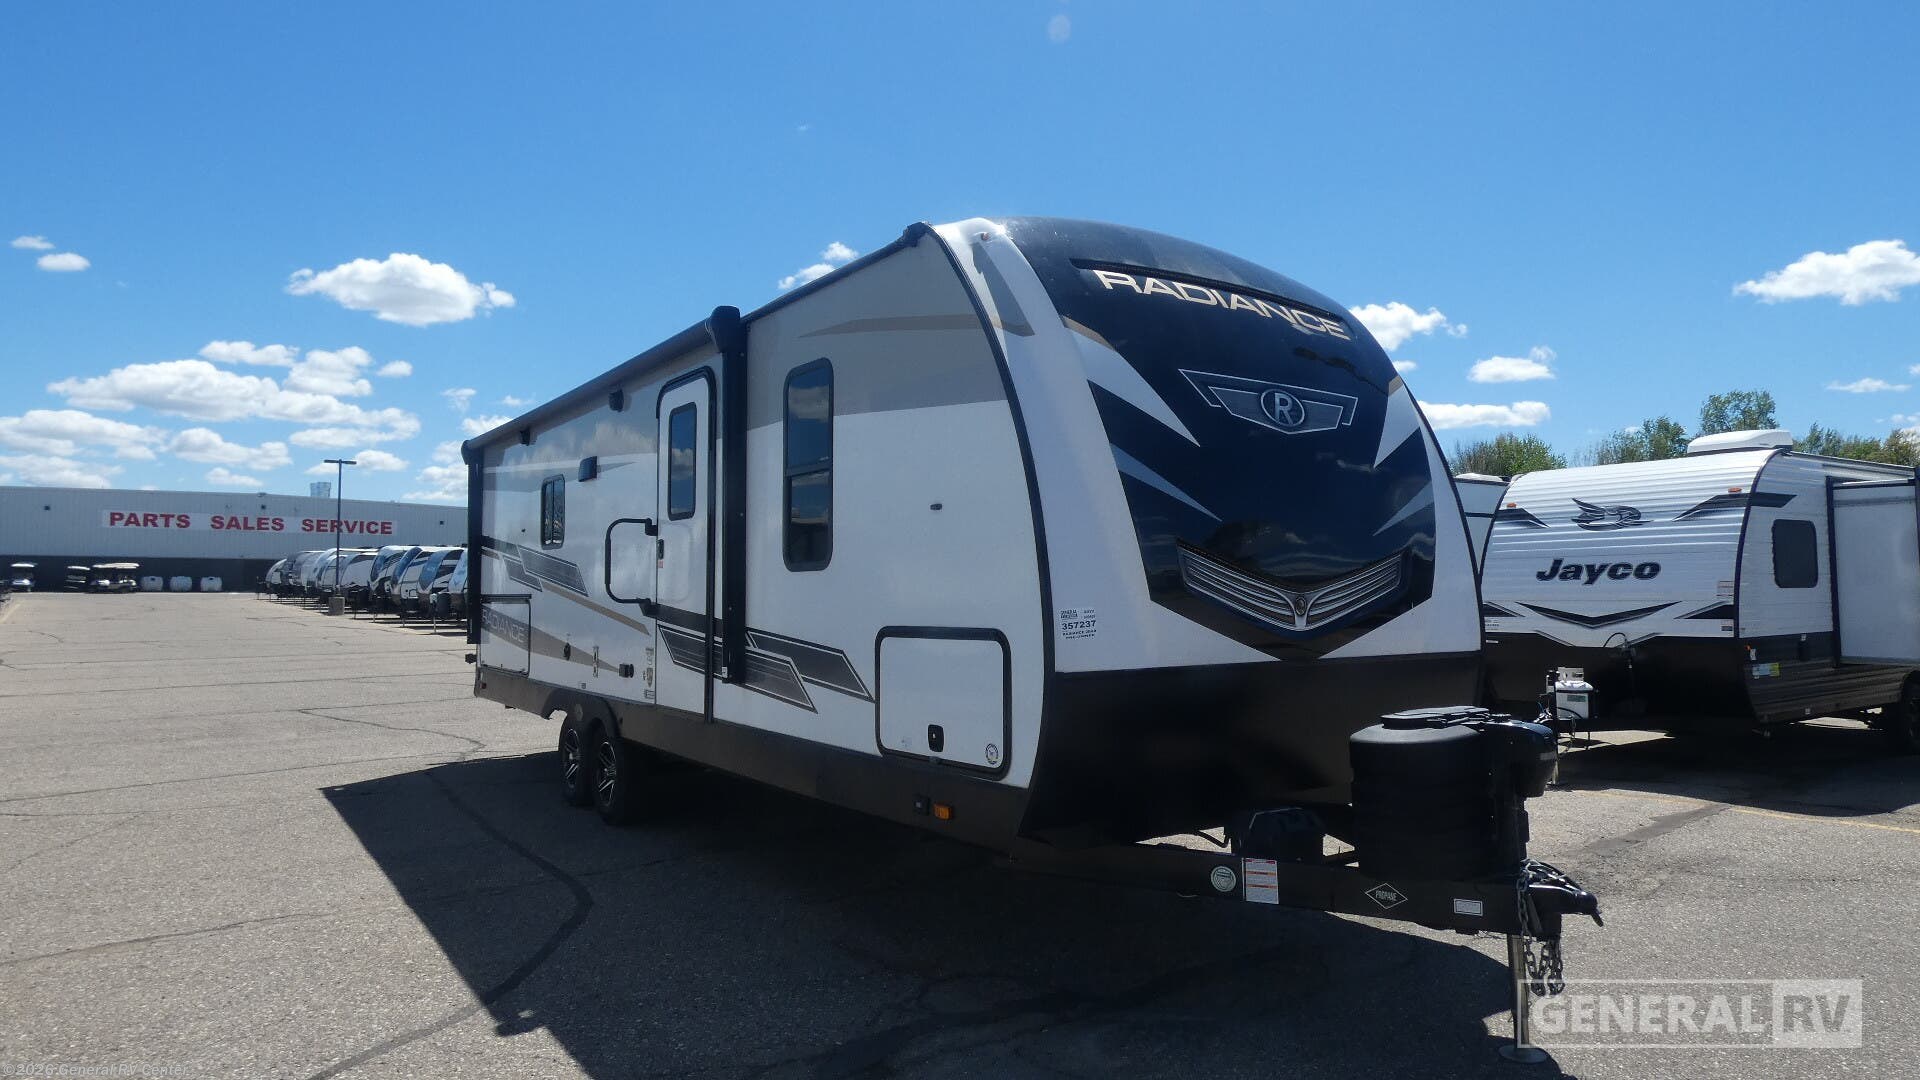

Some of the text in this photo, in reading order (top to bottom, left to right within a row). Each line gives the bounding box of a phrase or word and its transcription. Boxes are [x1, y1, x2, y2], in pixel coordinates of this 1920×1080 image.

[1092, 268, 1352, 341] RADIANCE
[1274, 392, 1294, 426] R
[109, 511, 393, 535] PARTS SALES SERVICE
[1535, 557, 1662, 586] Jayco
[1061, 620, 1096, 631] 357237
[1375, 890, 1398, 902] PROPANE
